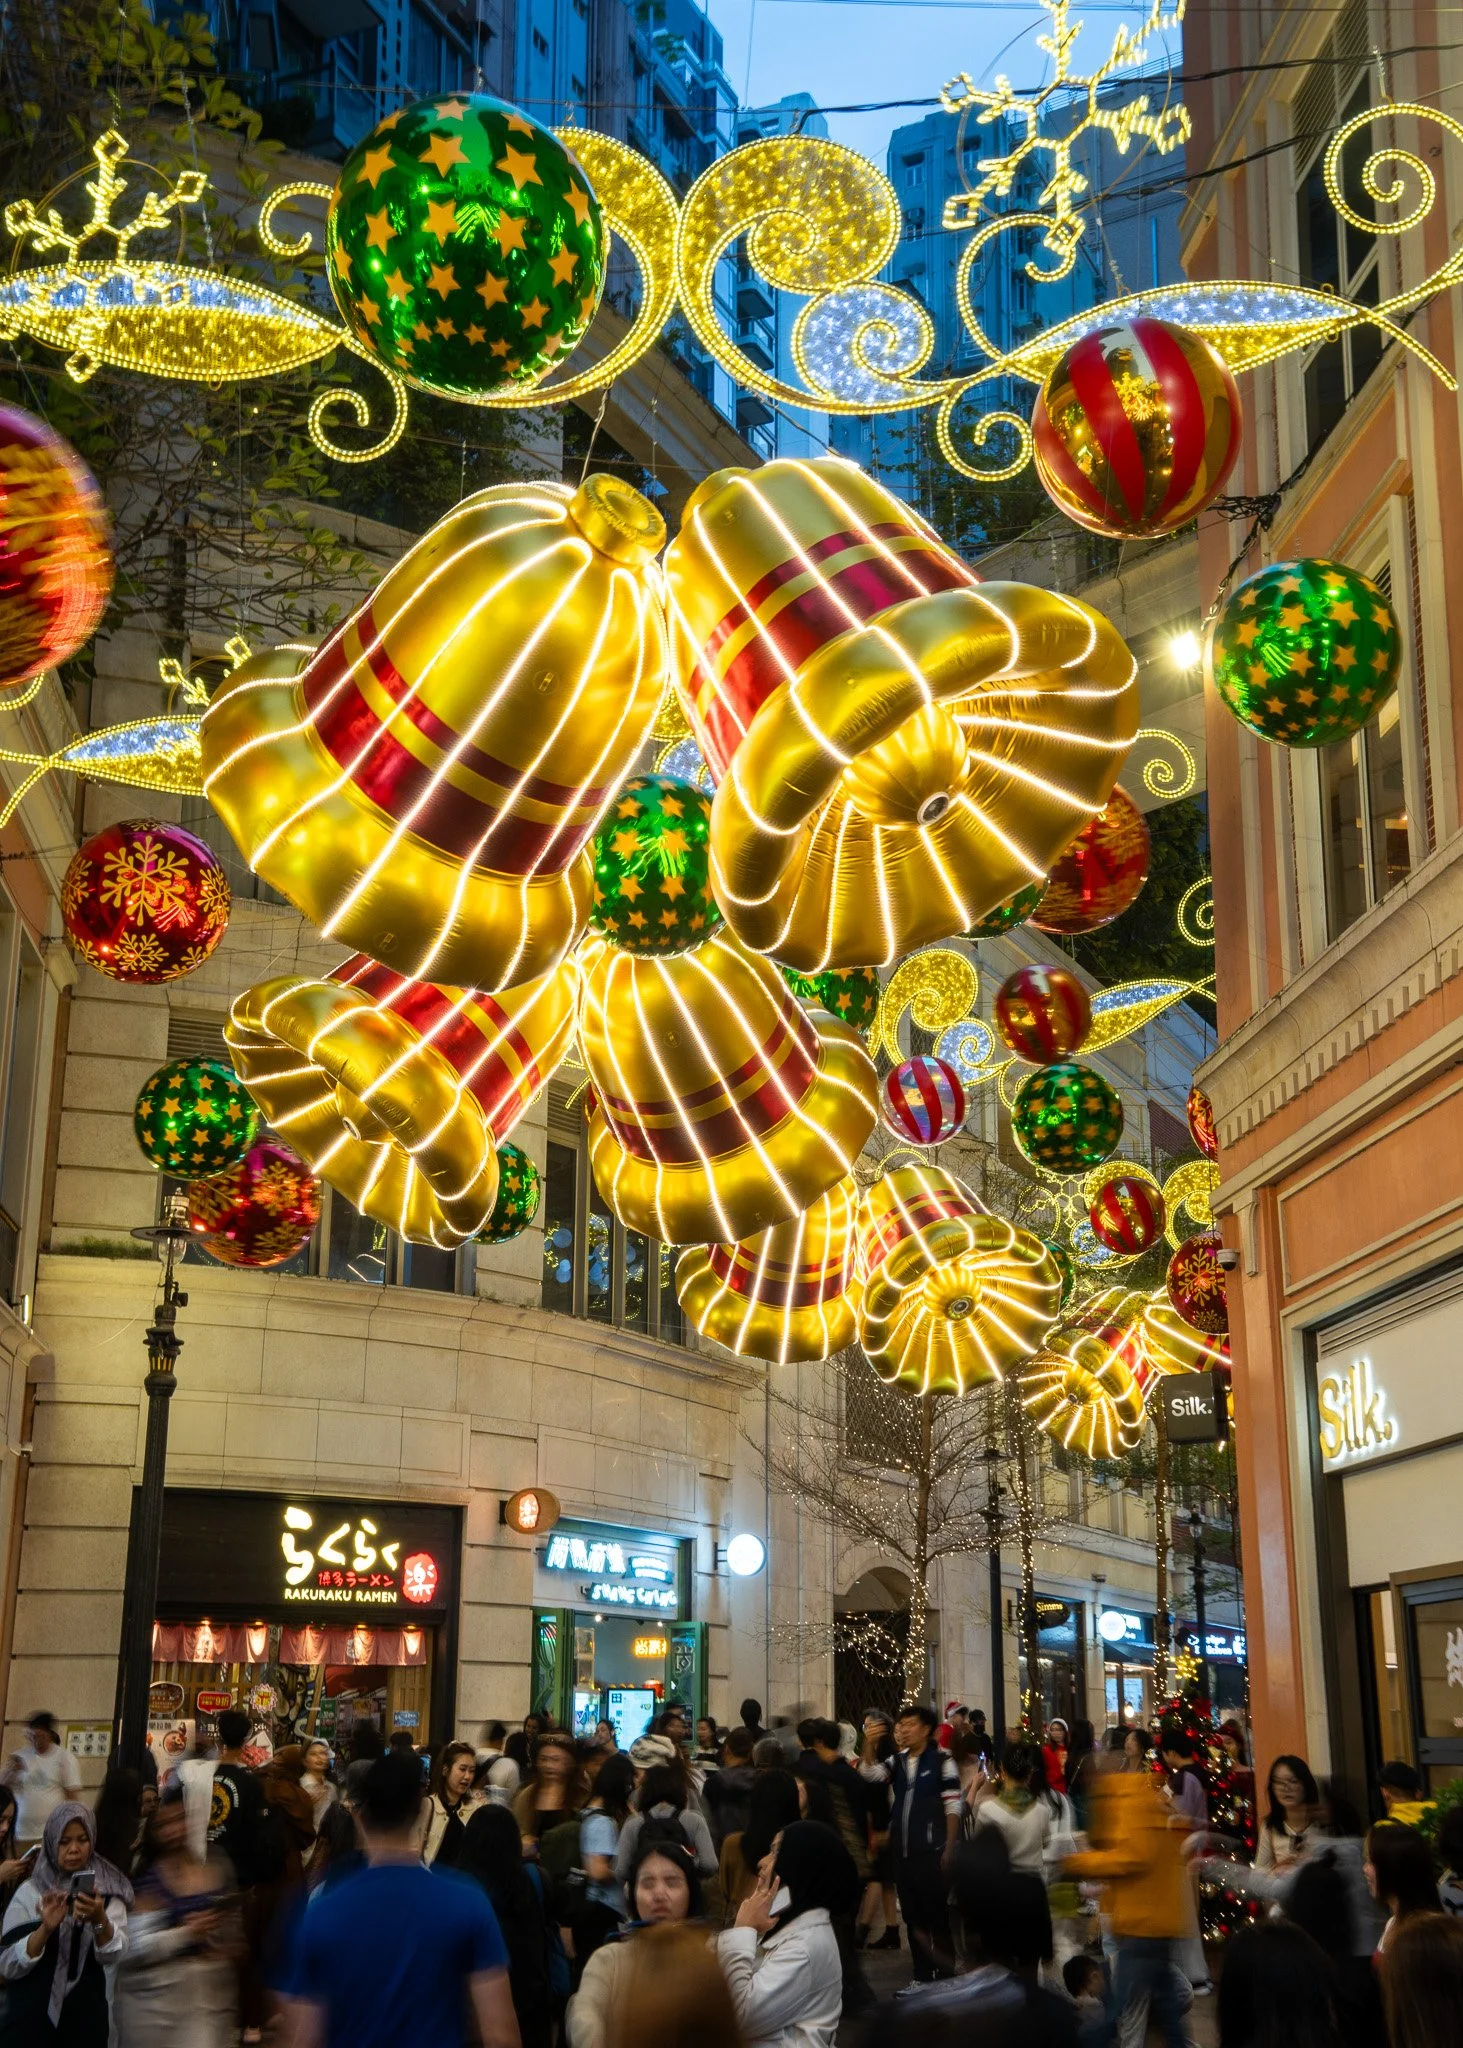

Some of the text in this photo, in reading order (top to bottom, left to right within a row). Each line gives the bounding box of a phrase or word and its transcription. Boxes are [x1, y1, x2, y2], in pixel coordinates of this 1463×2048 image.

[1171, 1396, 1212, 1416] Silk.
[1318, 1361, 1393, 1459] Silk.
[281, 1506, 400, 1585] らくらく
[318, 1571, 394, 1587] 博多ラーメン
[285, 1588, 397, 1603] RAKURAKU RAMEN
